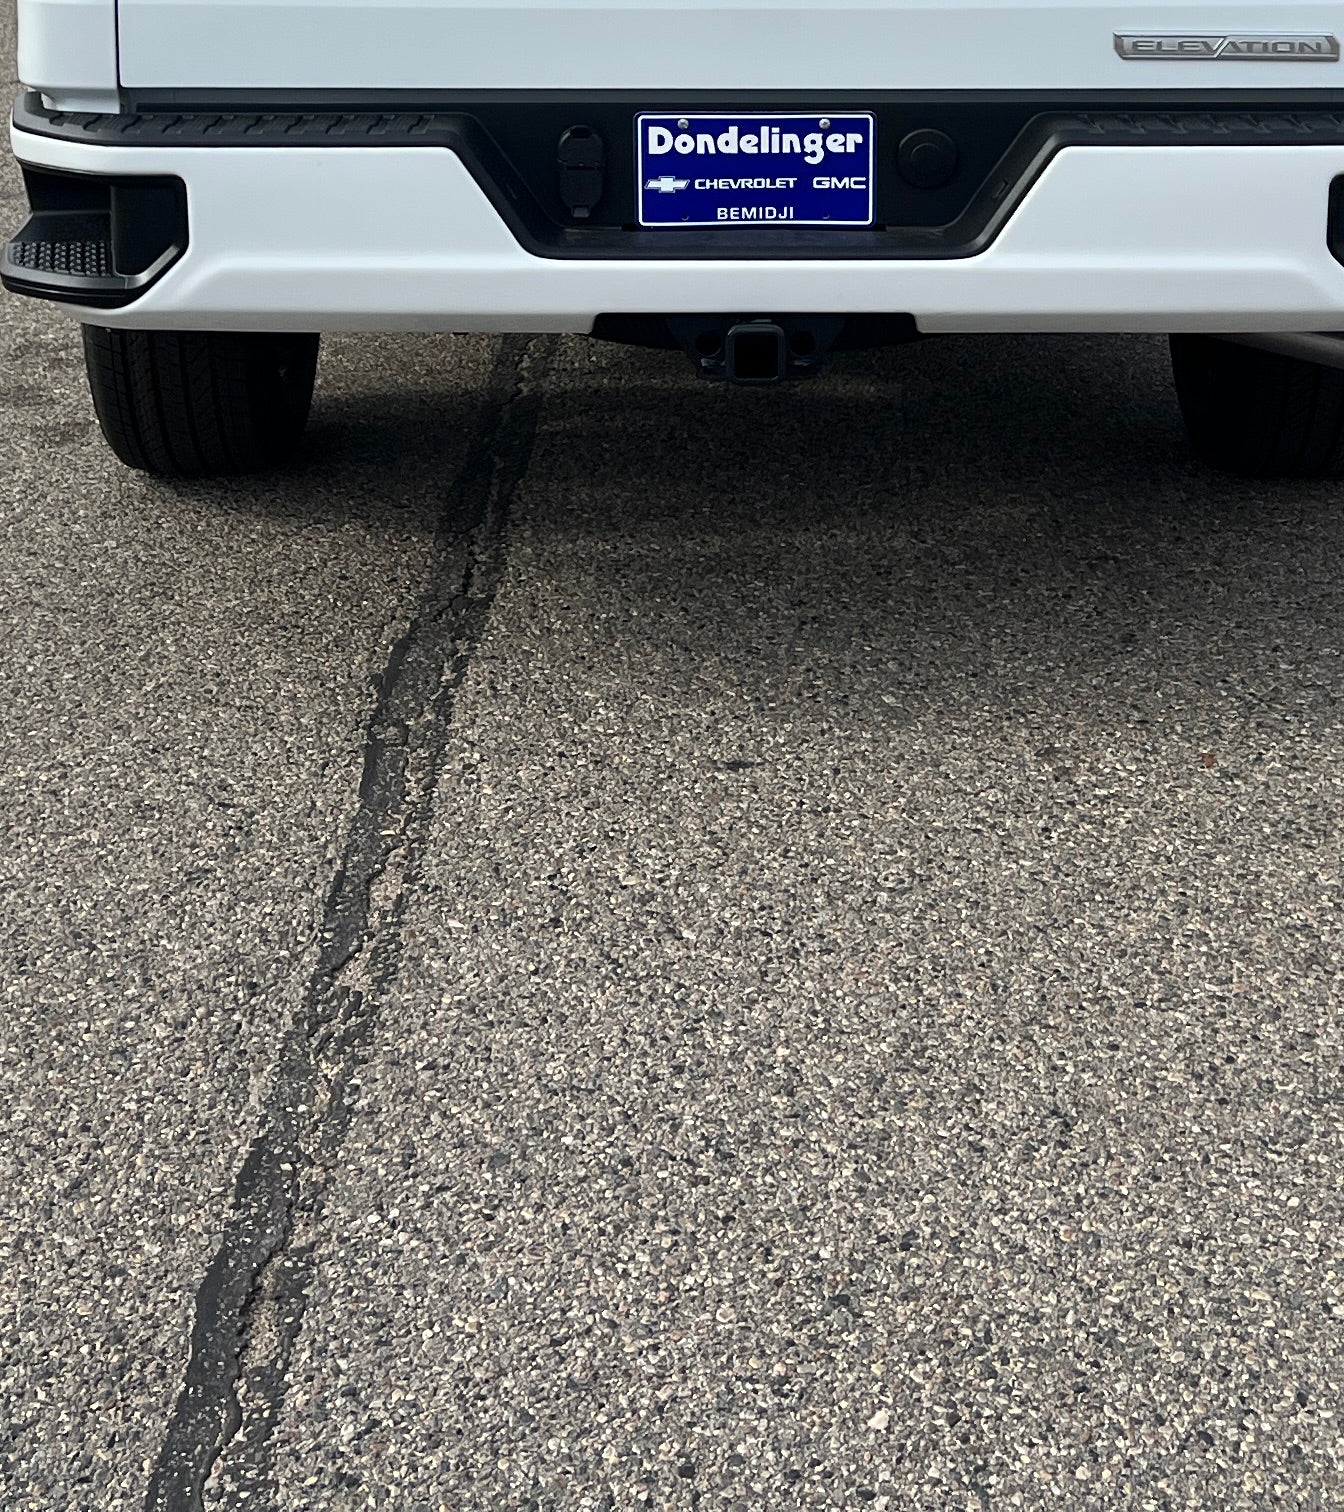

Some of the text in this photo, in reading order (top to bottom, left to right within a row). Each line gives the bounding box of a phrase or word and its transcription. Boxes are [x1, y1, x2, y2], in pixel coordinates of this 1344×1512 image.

[1132, 38, 1322, 55] ELEVATION
[648, 126, 863, 165] Dondelinger
[694, 177, 867, 190] CHEVROLET GMC
[717, 206, 794, 220] BEMIDJI
